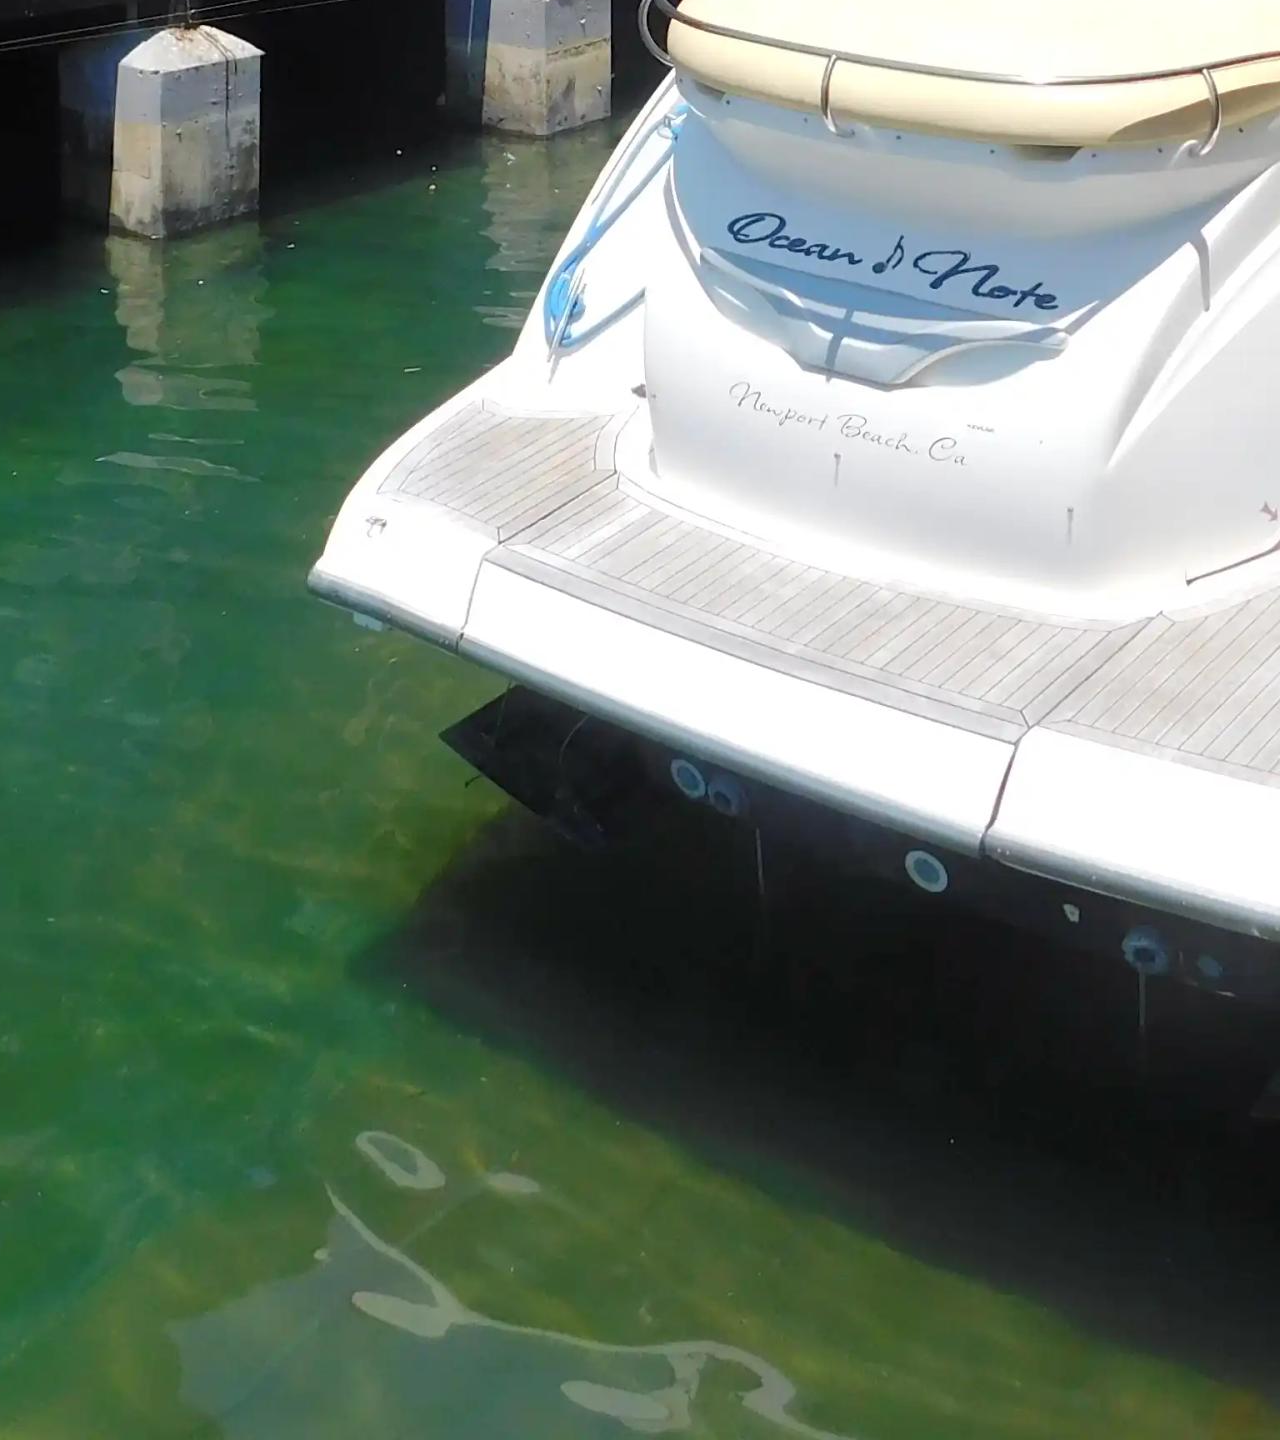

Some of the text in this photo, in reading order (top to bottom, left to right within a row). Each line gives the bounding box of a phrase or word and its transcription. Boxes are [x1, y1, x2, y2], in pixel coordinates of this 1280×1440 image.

[727, 212, 1058, 310] Ocean Note
[729, 381, 828, 431] Newport
[928, 436, 967, 466] Ca
